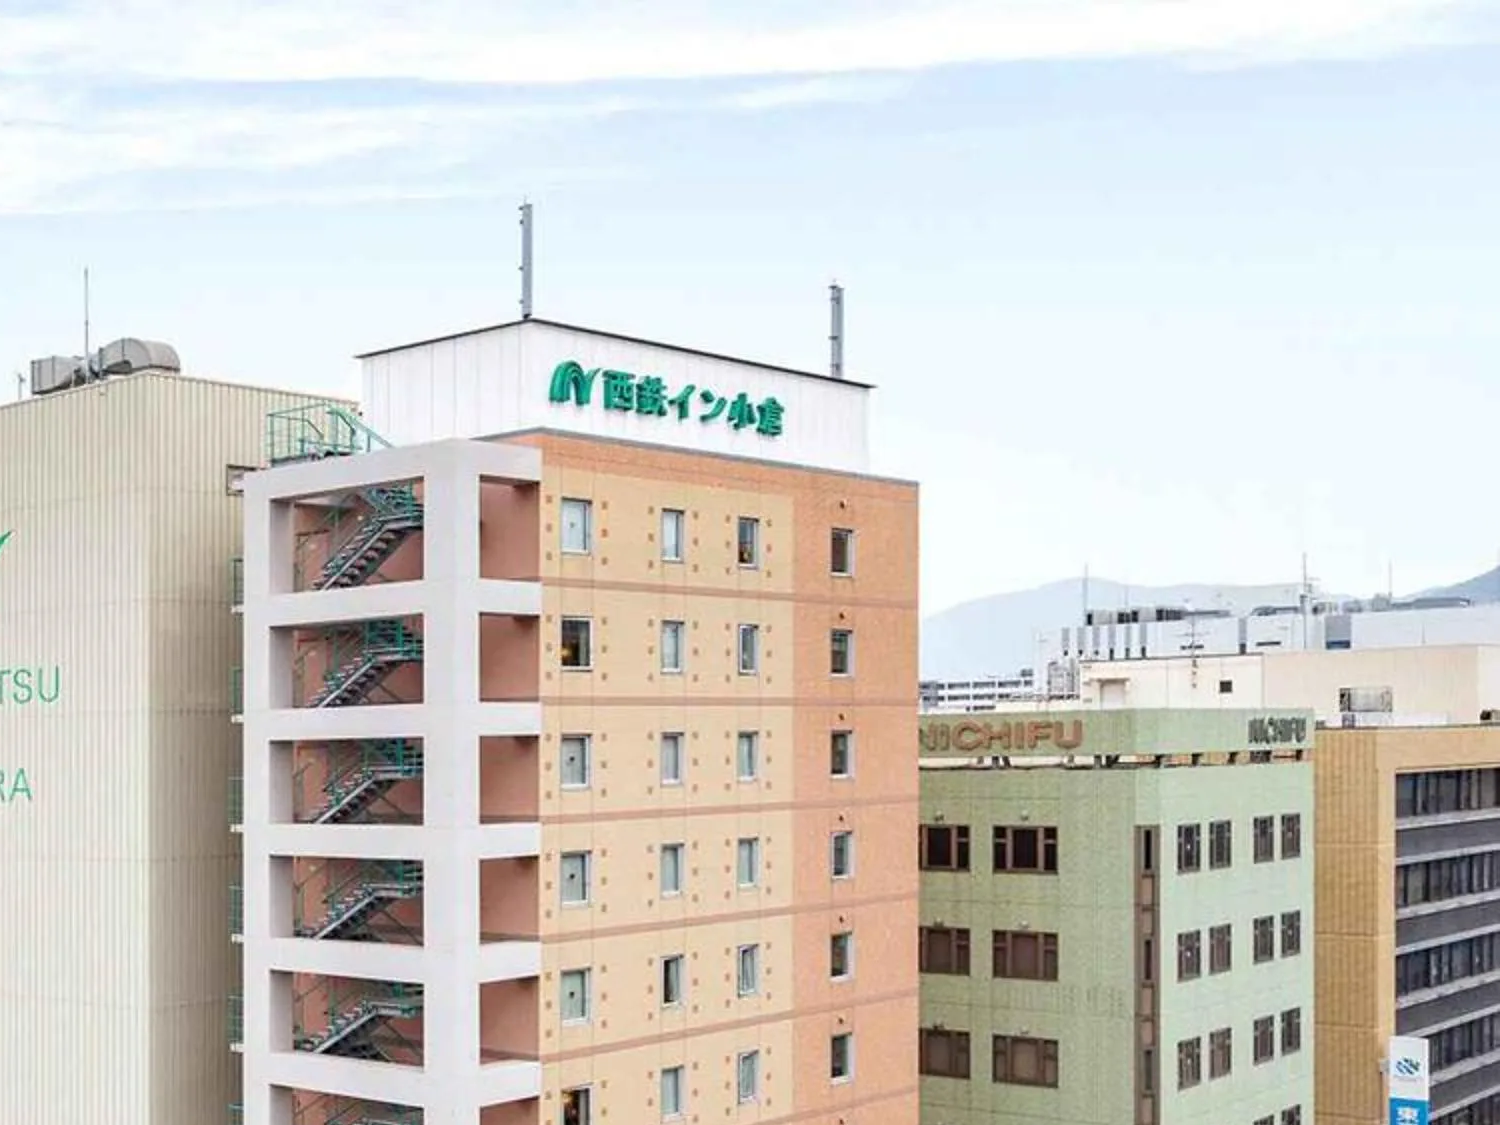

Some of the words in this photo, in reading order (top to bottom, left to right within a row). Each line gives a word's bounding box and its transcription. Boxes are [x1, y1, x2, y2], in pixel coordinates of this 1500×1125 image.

[602, 370, 785, 436] 西鉄イン小倉
